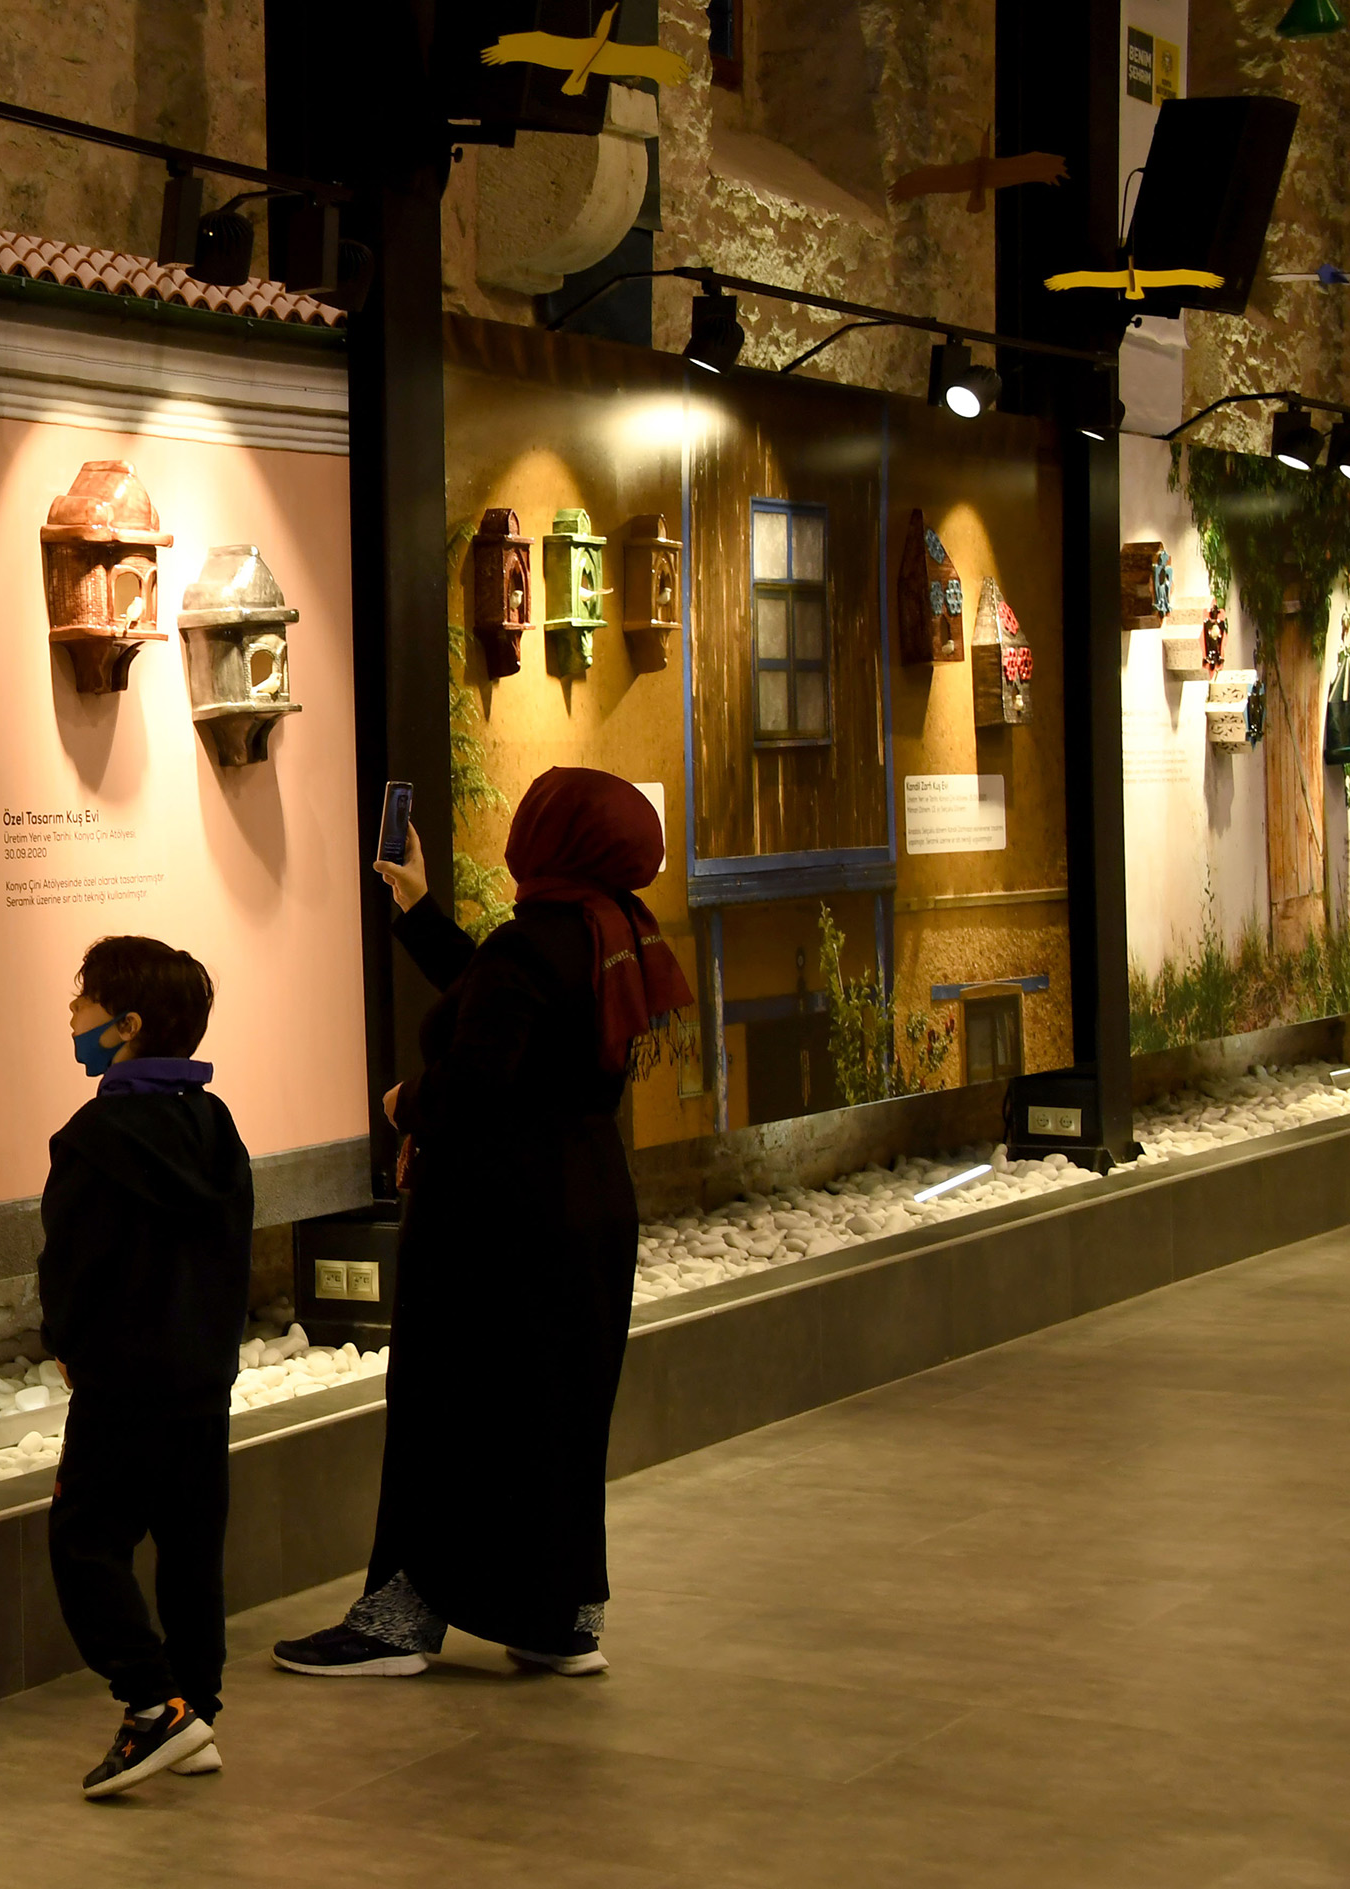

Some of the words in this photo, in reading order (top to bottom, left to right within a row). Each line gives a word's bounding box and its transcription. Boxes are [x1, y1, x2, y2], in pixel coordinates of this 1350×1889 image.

[3, 809, 24, 826] Özel
[26, 811, 64, 825] Tasarım
[66, 811, 82, 827] Kuş
[85, 810, 99, 823] Evi
[4, 832, 28, 844] Üretim
[43, 834, 51, 842] ve
[74, 831, 95, 842] Konya
[4, 848, 47, 860] 30.09.2020
[6, 881, 27, 893] Konya
[28, 880, 41, 893] Çini
[43, 879, 82, 891] Atölyesinde
[83, 877, 97, 887] özel
[98, 876, 118, 886] olarak
[6, 895, 36, 907] Seramik
[36, 895, 61, 905] üzerine
[63, 895, 72, 904] sır
[72, 894, 83, 903] altı
